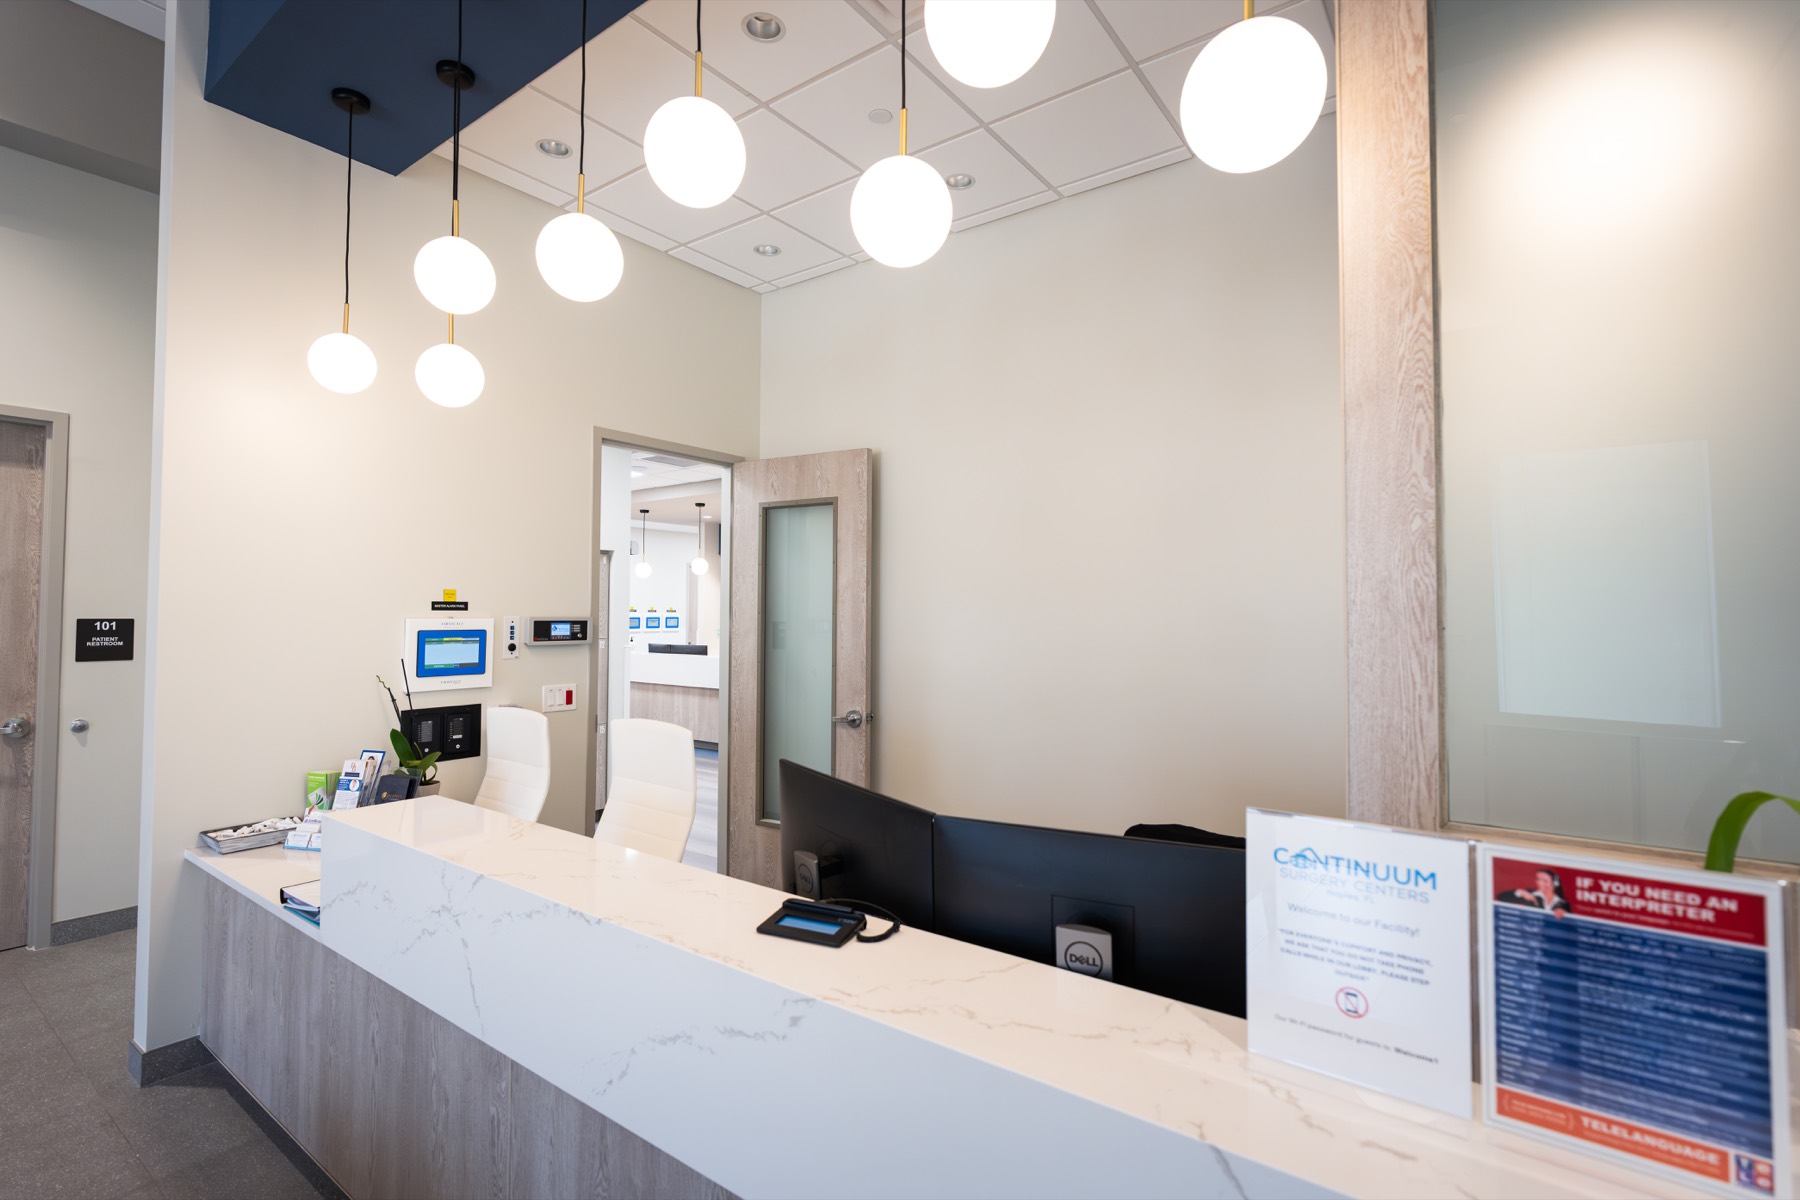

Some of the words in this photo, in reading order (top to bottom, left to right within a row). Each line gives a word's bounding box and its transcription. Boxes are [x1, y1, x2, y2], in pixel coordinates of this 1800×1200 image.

[94, 621, 116, 631] 101
[599, 726, 606, 734] 15
[1279, 867, 1347, 888] SURGERY
[1353, 880, 1430, 904] CENTERS
[1575, 876, 1595, 889] IF
[1599, 880, 1640, 897] YOU
[1644, 886, 1703, 906] NEED
[1706, 896, 1739, 913] AN
[1287, 902, 1337, 919] Welcome
[1340, 912, 1351, 923] to
[1353, 917, 1372, 926] our
[1374, 917, 1420, 937] Facility!
[1575, 889, 1716, 923] INTERPRETER
[1069, 953, 1099, 968] DELL
[1580, 1115, 1721, 1167] TELELANGUAGE
